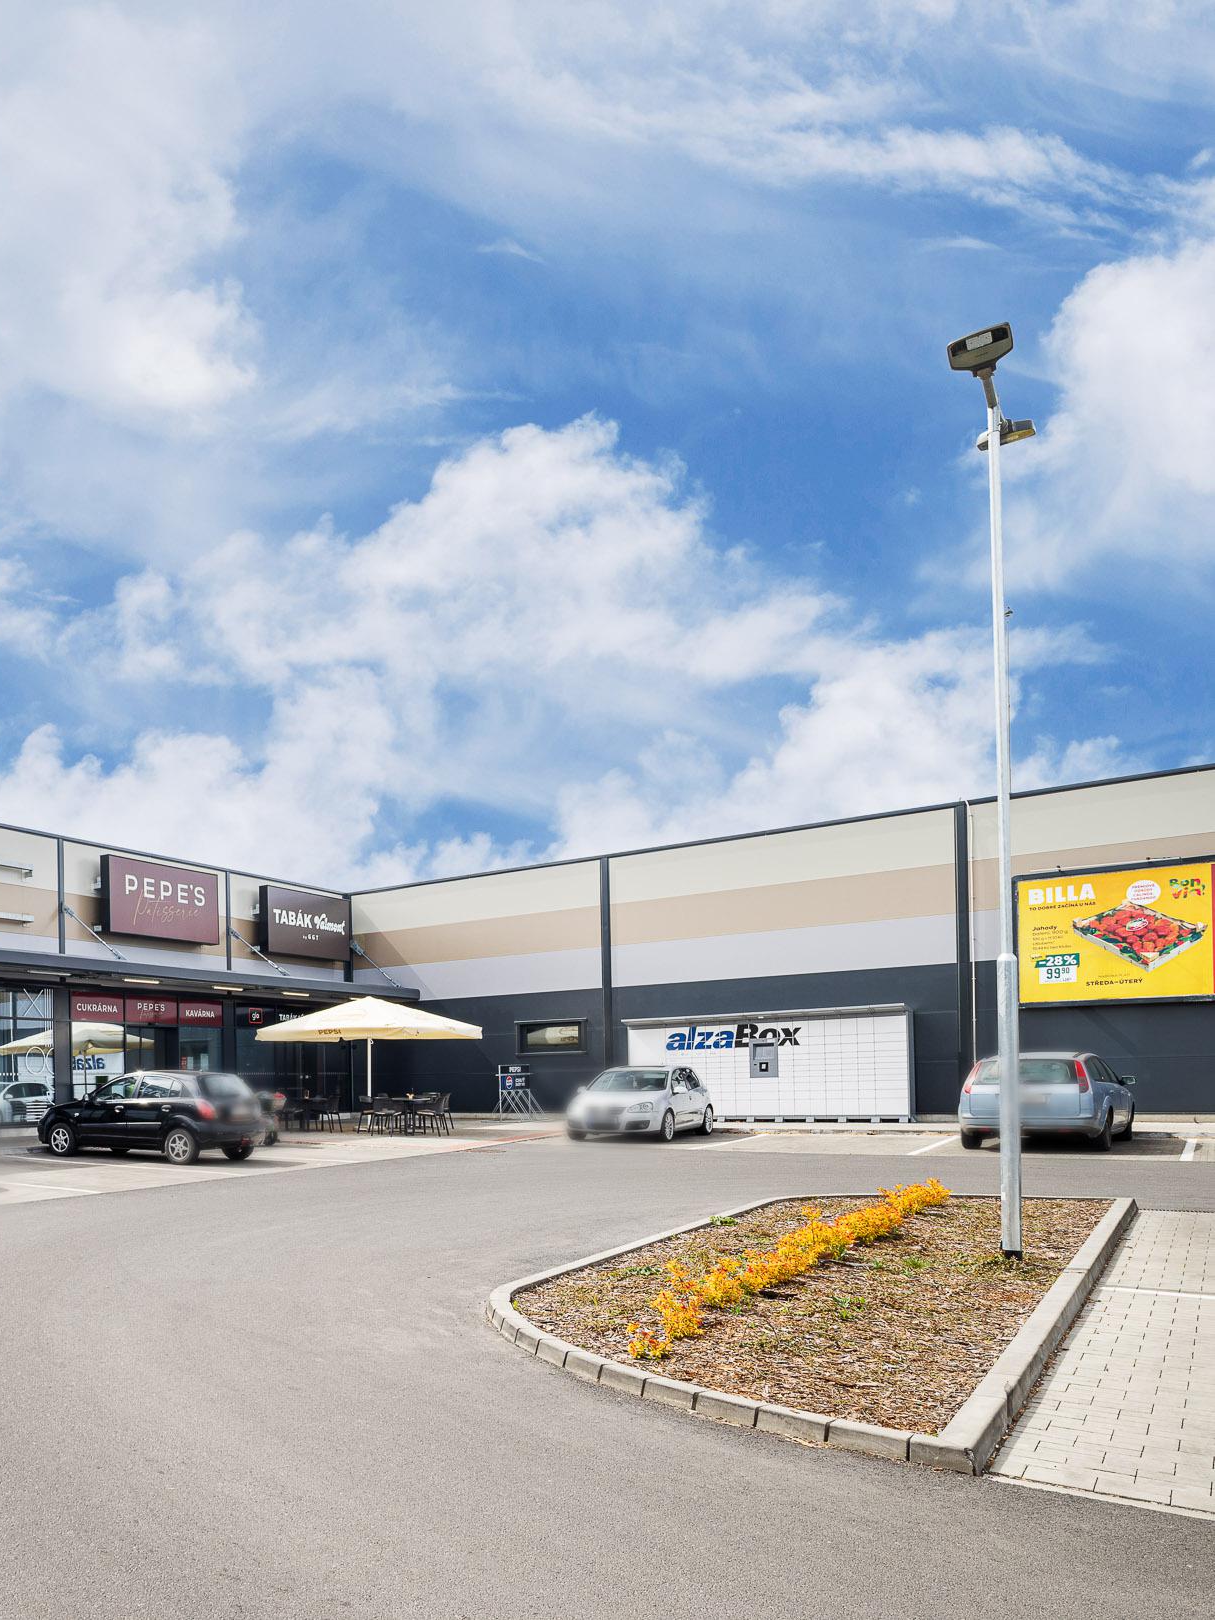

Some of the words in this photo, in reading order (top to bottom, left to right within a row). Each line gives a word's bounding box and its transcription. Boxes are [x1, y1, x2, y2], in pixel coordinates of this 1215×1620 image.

[125, 874, 206, 907] PEPE'S
[1028, 883, 1096, 906] BILLA
[273, 908, 313, 929] TABÁK
[1038, 955, 1077, 967] -28%
[76, 1002, 118, 1013] CUKRÁRNA
[137, 1002, 166, 1012] PEPE'S
[185, 1008, 215, 1018] KAVÁRNA
